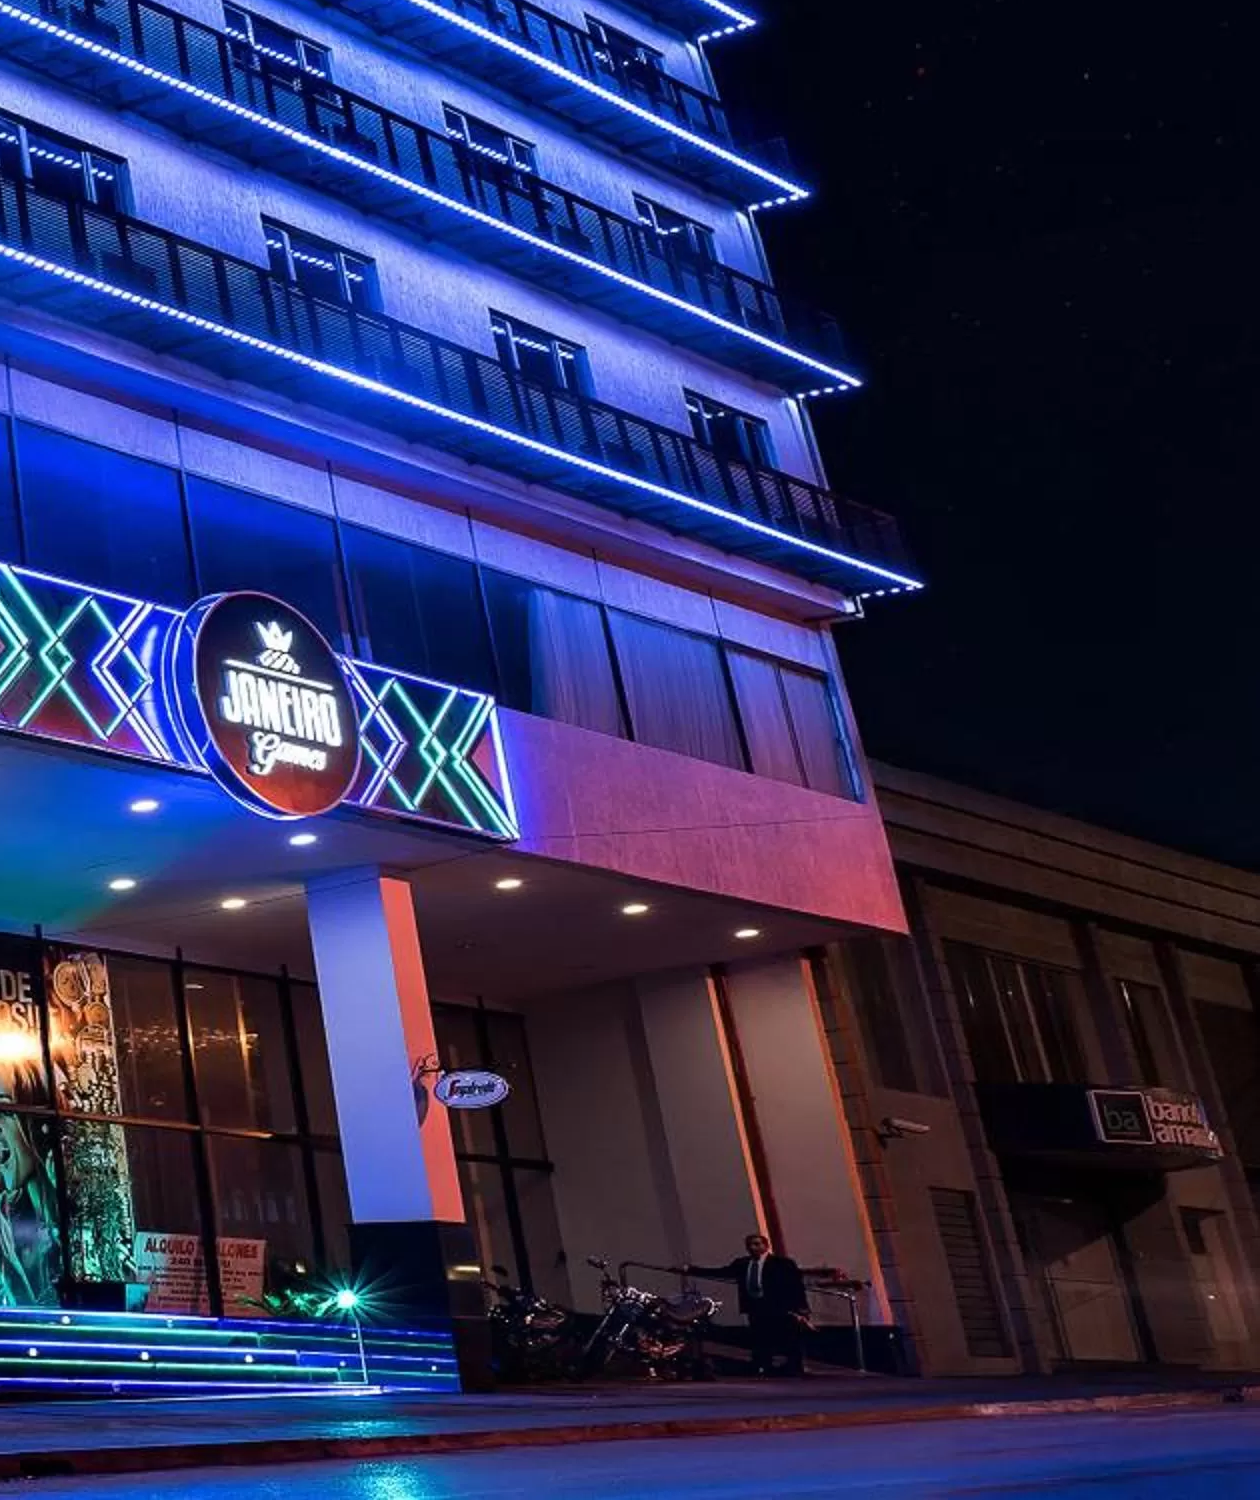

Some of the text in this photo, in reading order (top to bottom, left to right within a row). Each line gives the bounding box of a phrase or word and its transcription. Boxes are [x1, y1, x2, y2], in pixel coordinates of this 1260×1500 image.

[221, 669, 342, 747] JANEIRO
[252, 732, 327, 774] Games
[0, 969, 33, 1003] DE
